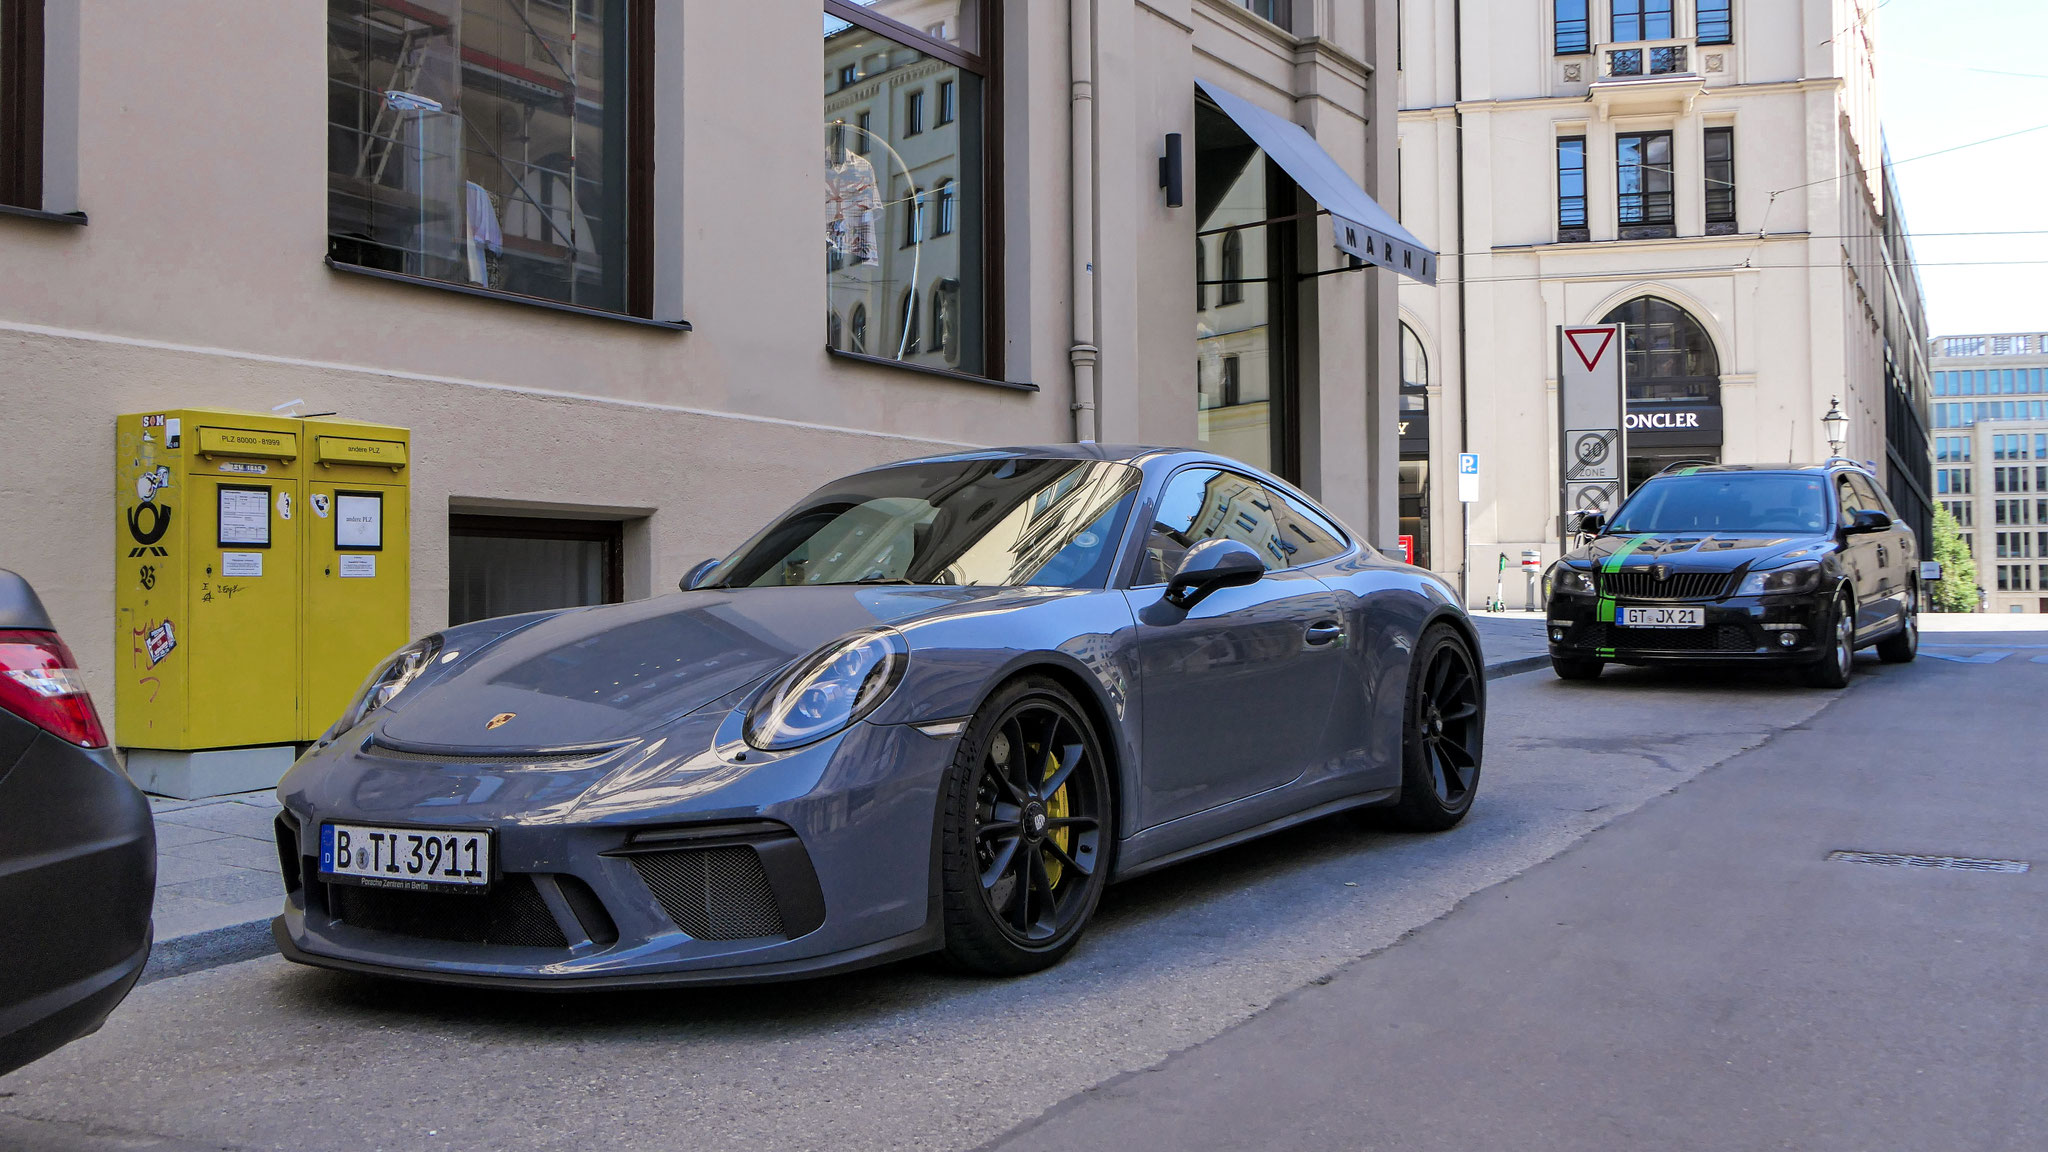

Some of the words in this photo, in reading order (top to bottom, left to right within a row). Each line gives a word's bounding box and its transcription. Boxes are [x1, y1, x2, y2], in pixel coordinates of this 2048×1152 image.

[1345, 226, 1427, 276] MARNI
[221, 435, 235, 443] PLZ
[236, 436, 257, 444] 80000
[261, 438, 280, 446] 81999
[1581, 442, 1602, 457] 30
[1461, 456, 1474, 473] P
[1579, 468, 1605, 477] ZONE
[1629, 609, 1647, 623] GT
[1655, 609, 1675, 624] JX
[1678, 610, 1696, 624] 21
[324, 852, 331, 864] D
[337, 831, 351, 868] B
[369, 833, 400, 873] TI
[406, 834, 482, 878] 3911
[361, 877, 383, 887] Porsche
[383, 879, 404, 889] Zentren
[411, 881, 429, 890] Berlin
